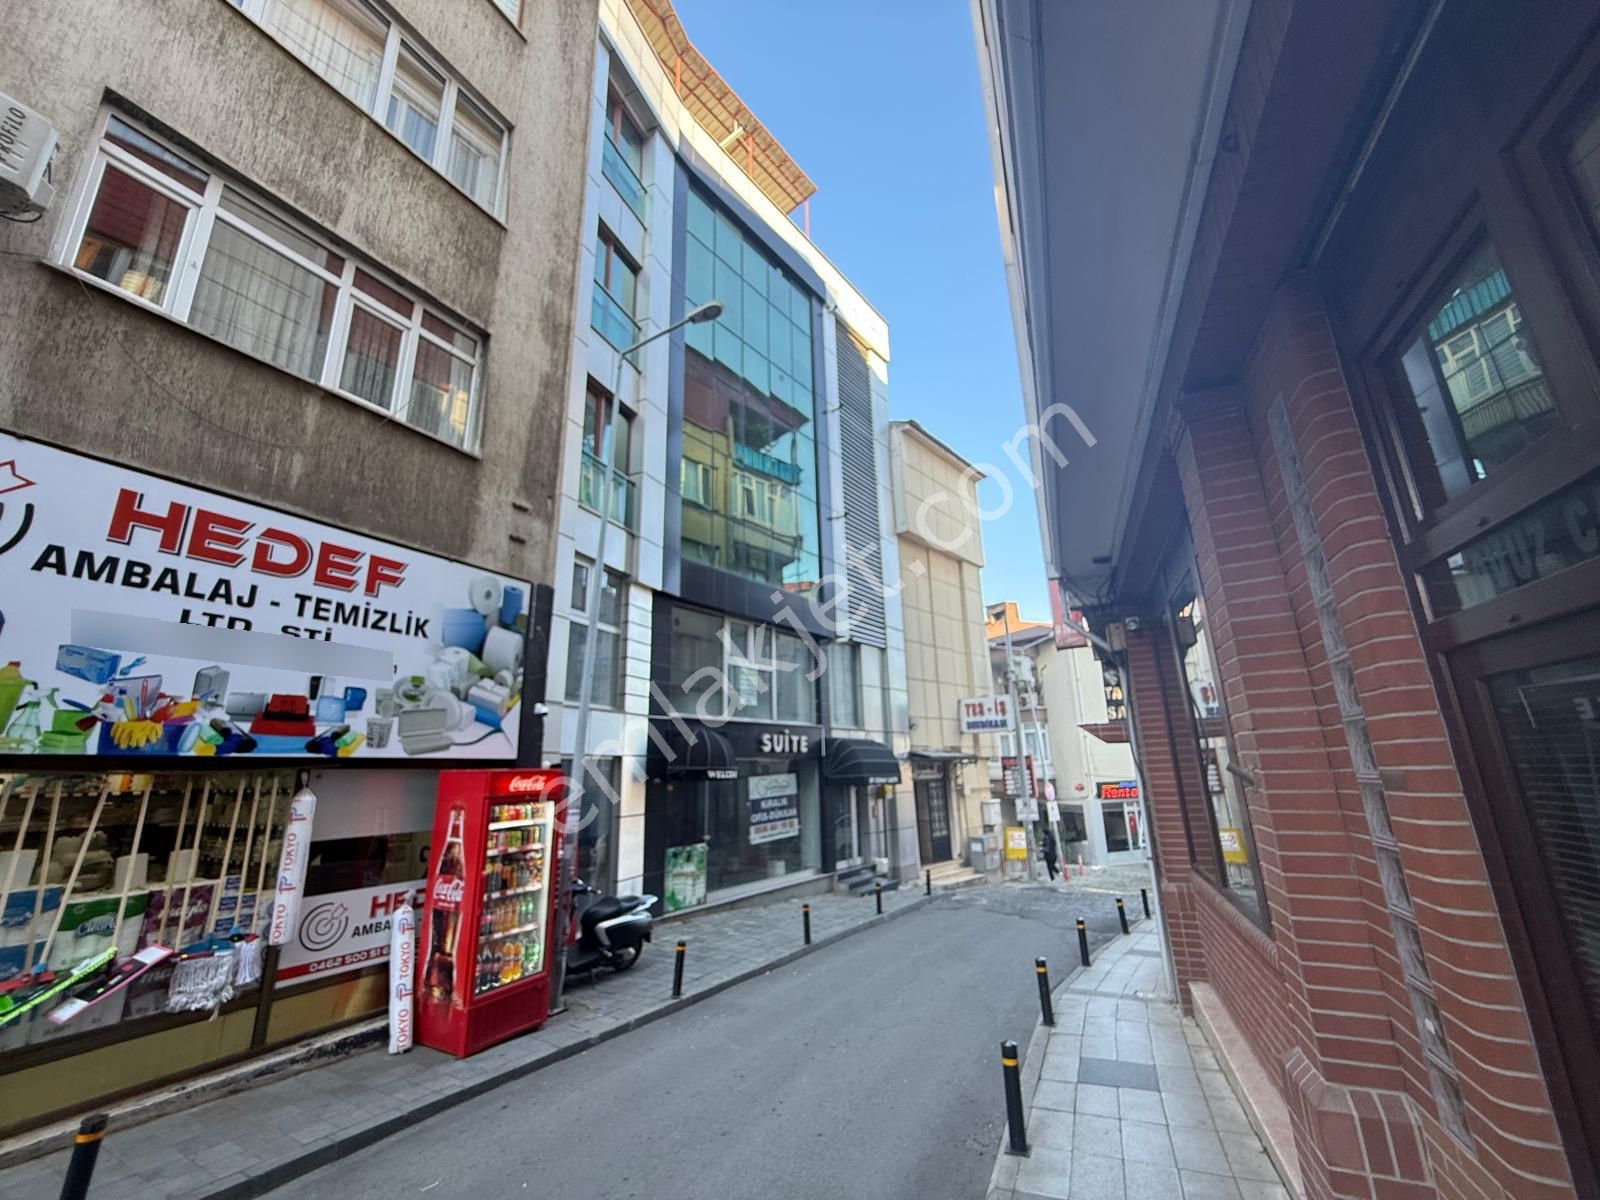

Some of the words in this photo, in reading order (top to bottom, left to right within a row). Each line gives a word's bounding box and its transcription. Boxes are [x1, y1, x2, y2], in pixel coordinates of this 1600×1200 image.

[0, 107, 26, 161] ROFİLO
[106, 487, 409, 596] HEDEF
[31, 543, 258, 608] AMBALAJ
[294, 593, 430, 638] TEMİZLİK
[761, 729, 809, 753] SUİTE
[283, 832, 297, 872] TOKYO
[351, 921, 391, 938] AMBA
[400, 941, 412, 978] TOKYO
[397, 1008, 409, 1049] TOKYO
